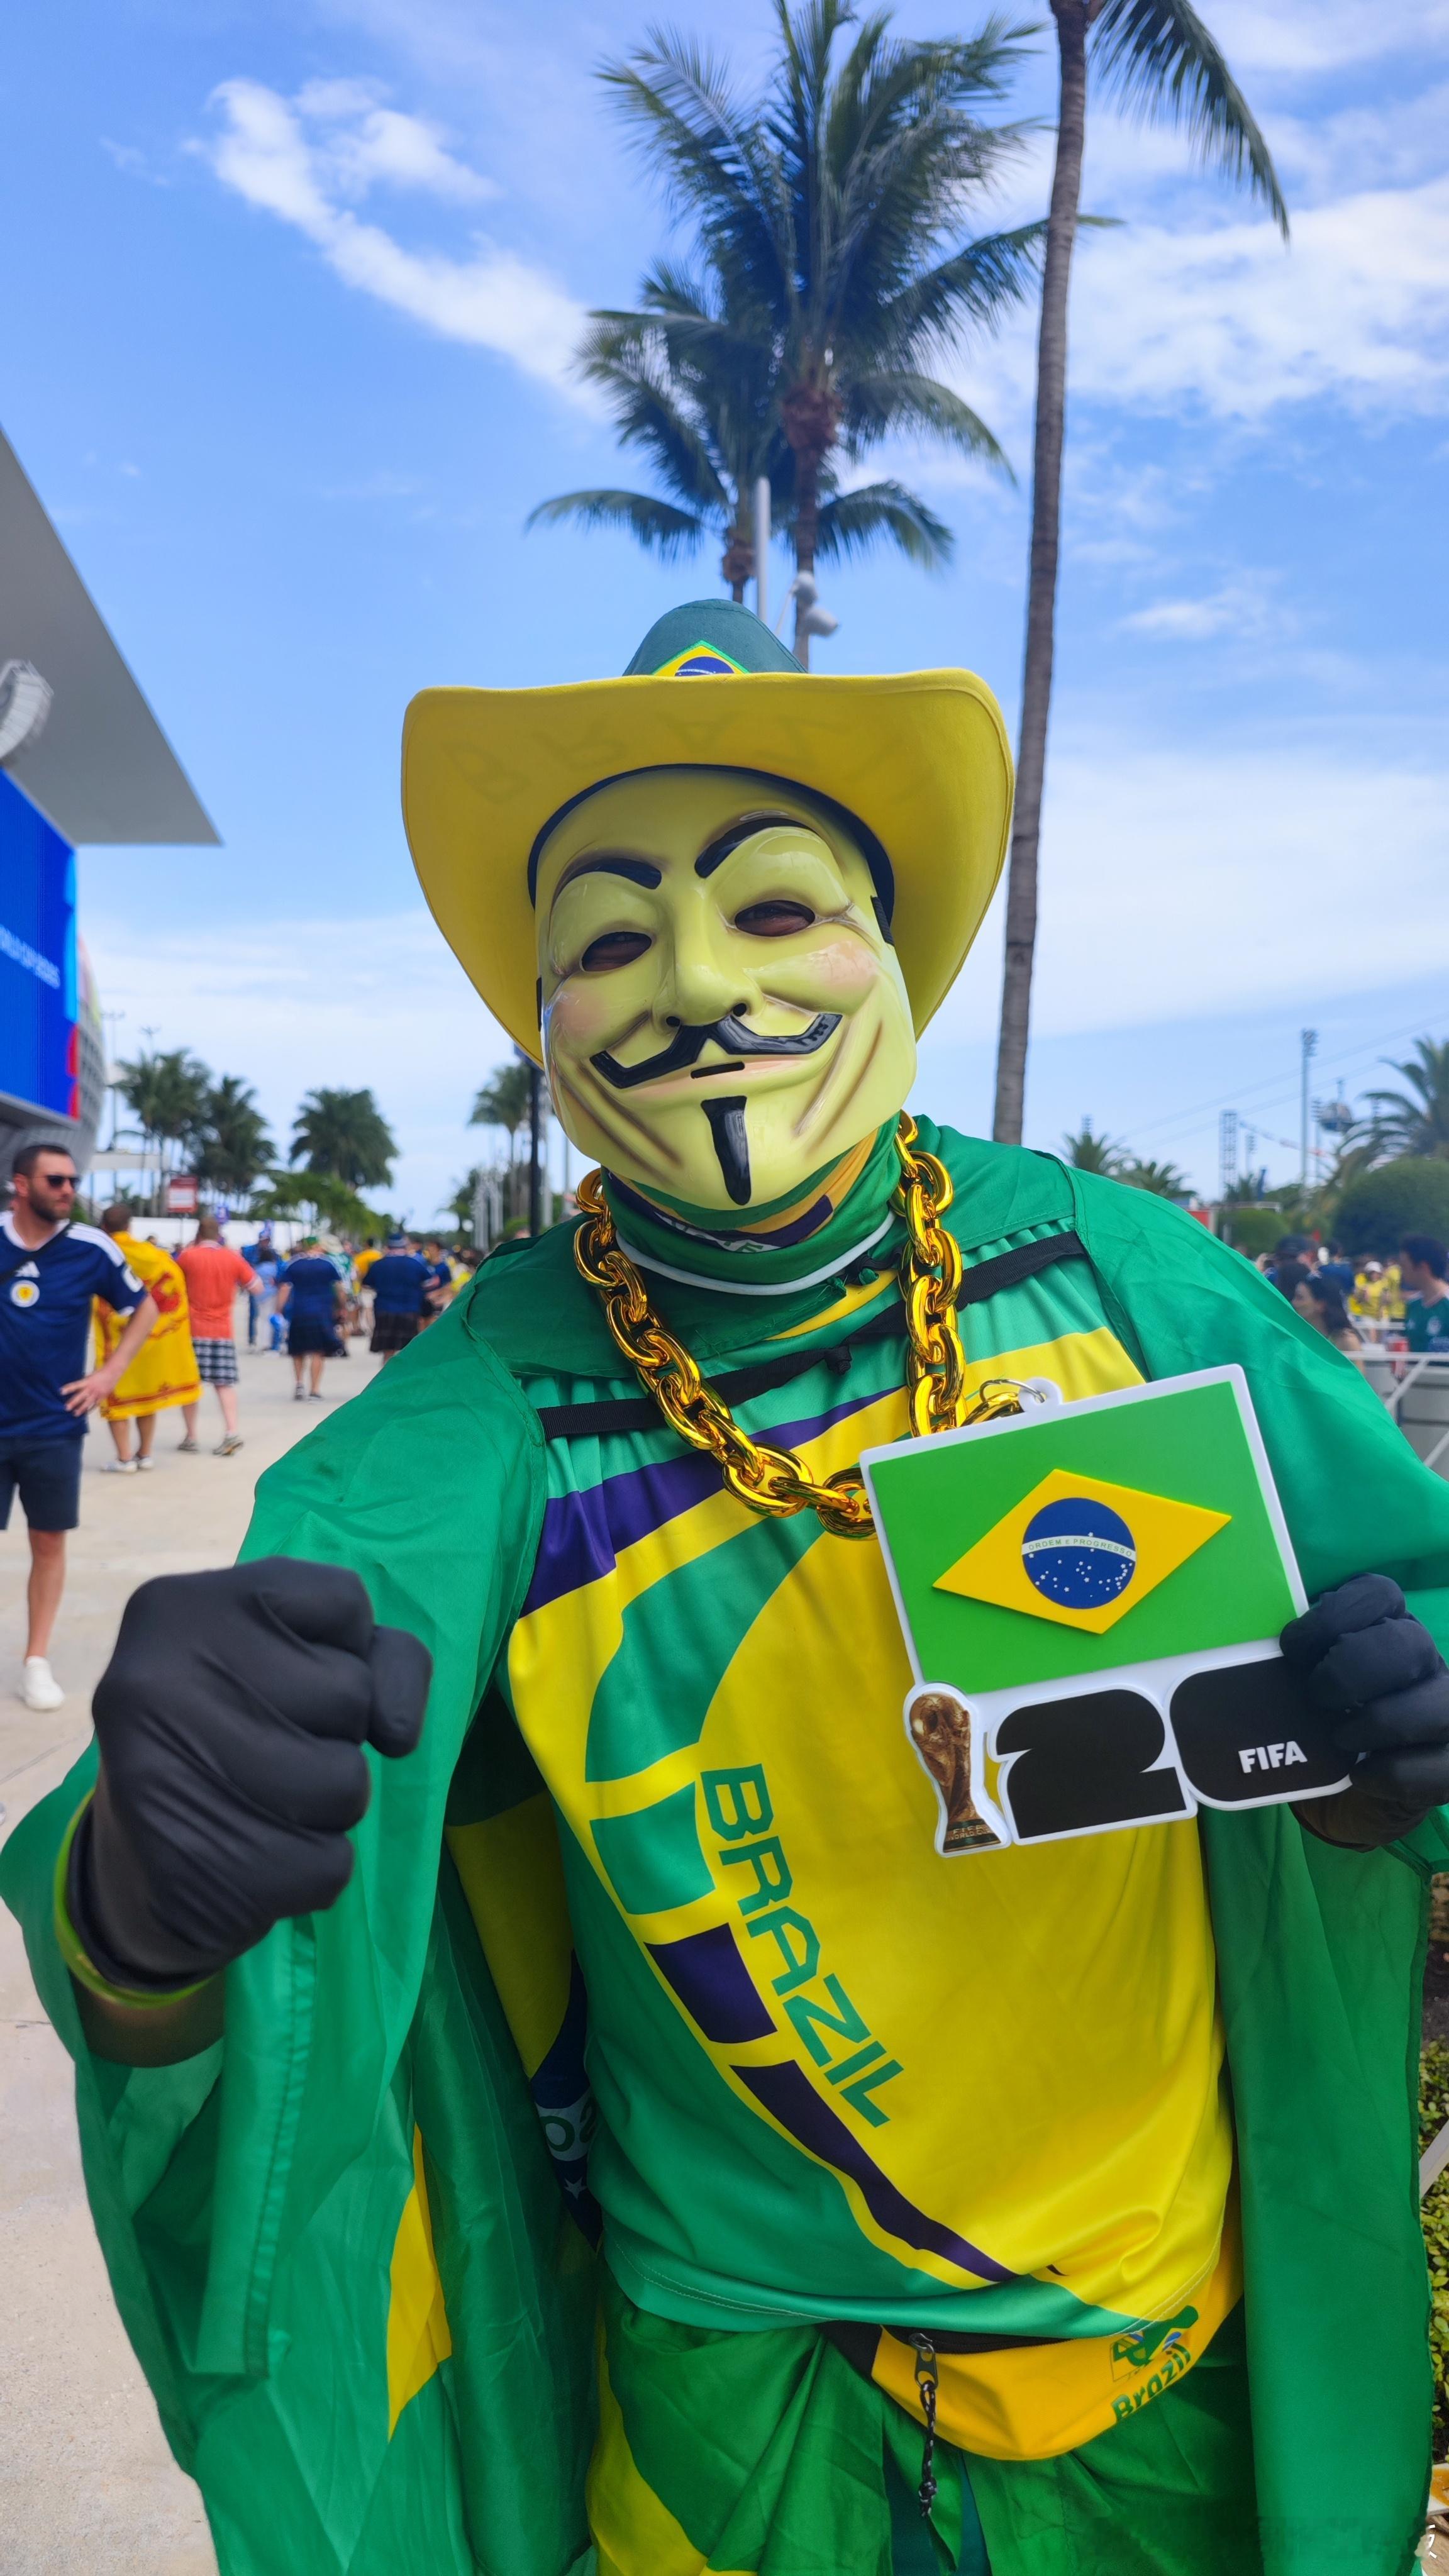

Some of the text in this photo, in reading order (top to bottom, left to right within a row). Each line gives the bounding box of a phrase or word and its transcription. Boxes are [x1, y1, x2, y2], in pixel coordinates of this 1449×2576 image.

[1028, 1538, 1062, 1551] ORDEM
[1073, 1538, 1132, 1557] PROGRESSO
[1238, 1740, 1308, 1774] FIFA
[699, 1763, 905, 2128] BRAZIL
[1111, 2341, 1191, 2421] Brazil
